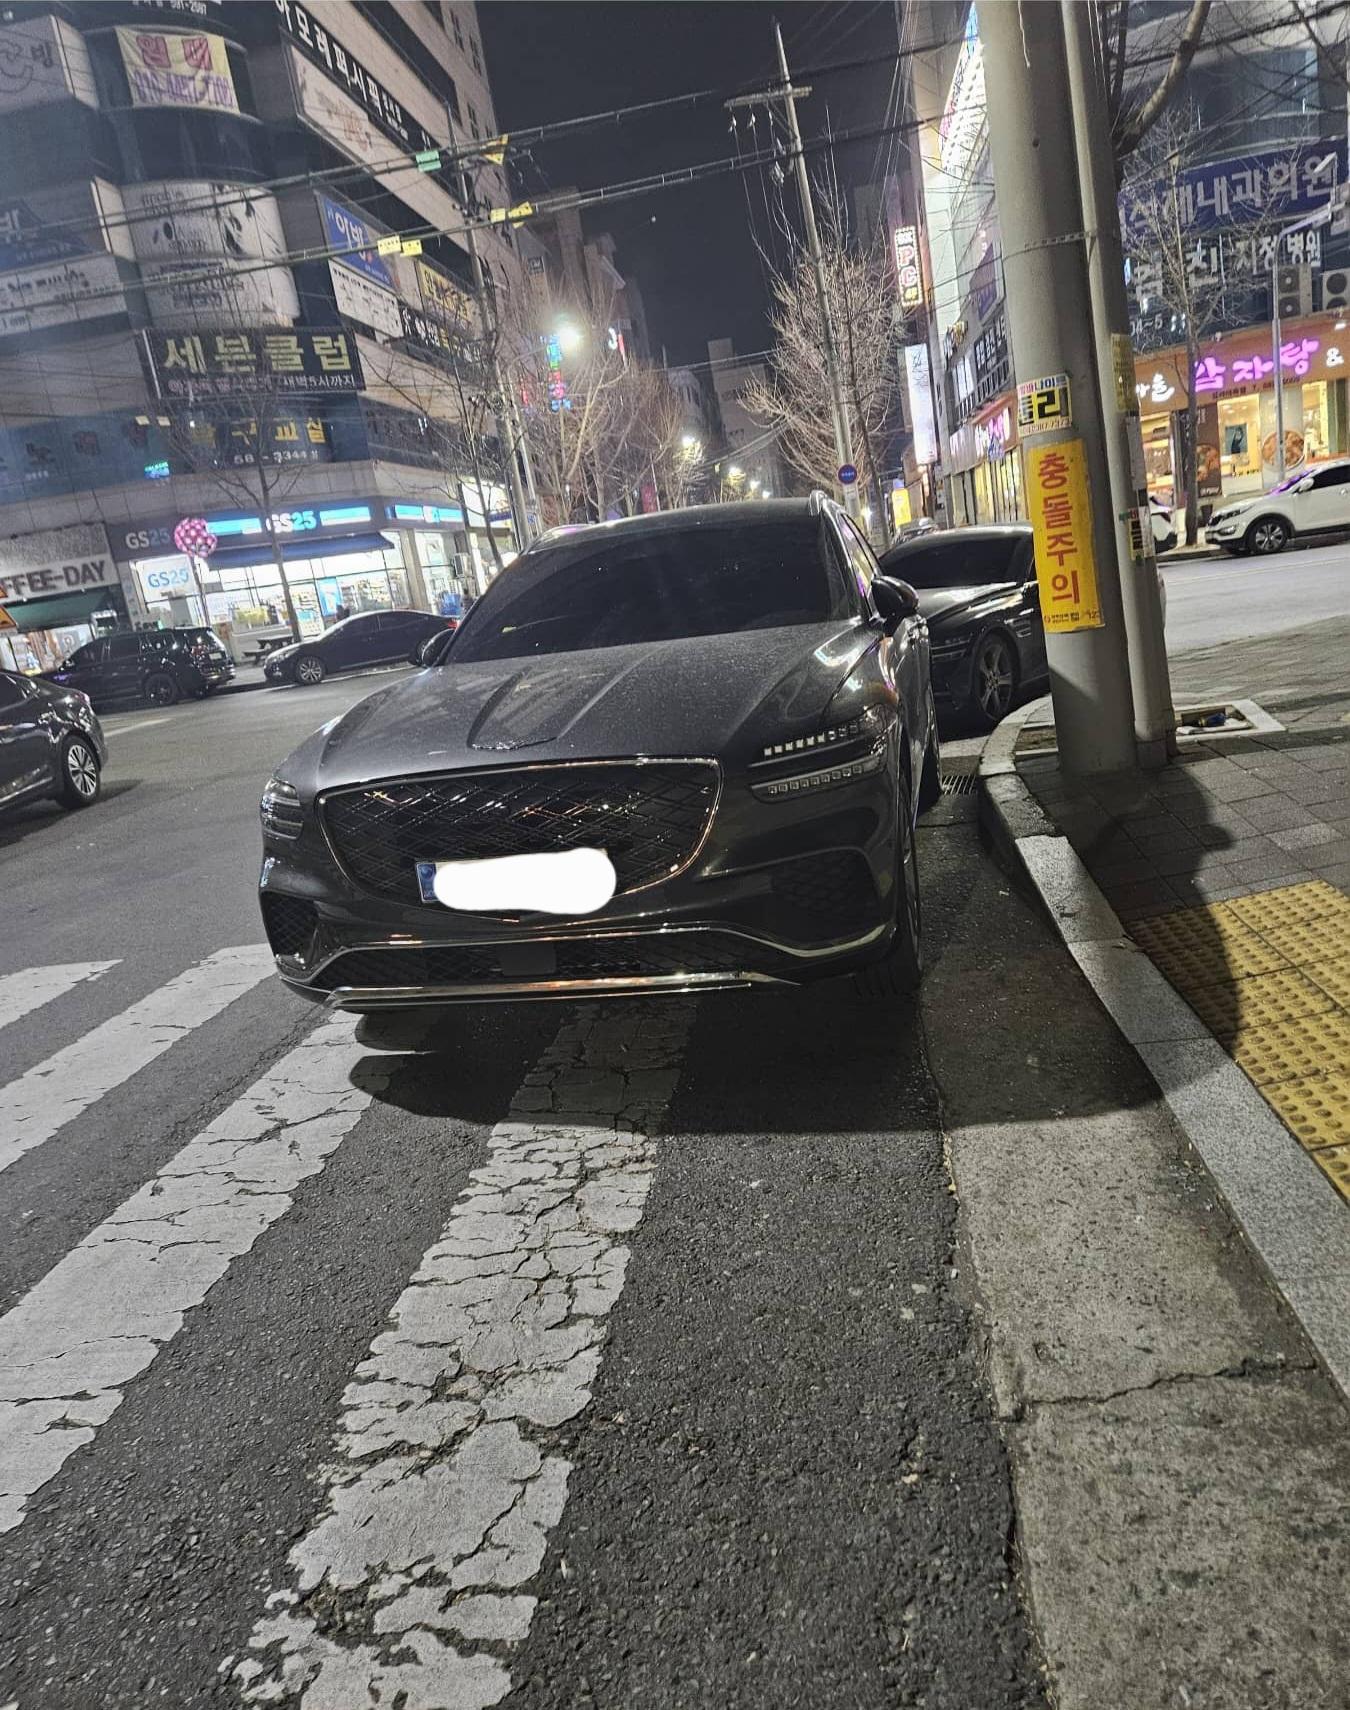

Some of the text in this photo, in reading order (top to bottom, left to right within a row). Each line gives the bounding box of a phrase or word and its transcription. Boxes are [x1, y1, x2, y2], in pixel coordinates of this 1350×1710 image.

[265, 510, 317, 533] GS25
[1038, 452, 1080, 605] 충돌주의
[125, 528, 171, 549] GS25
[148, 569, 189, 588] GS25
